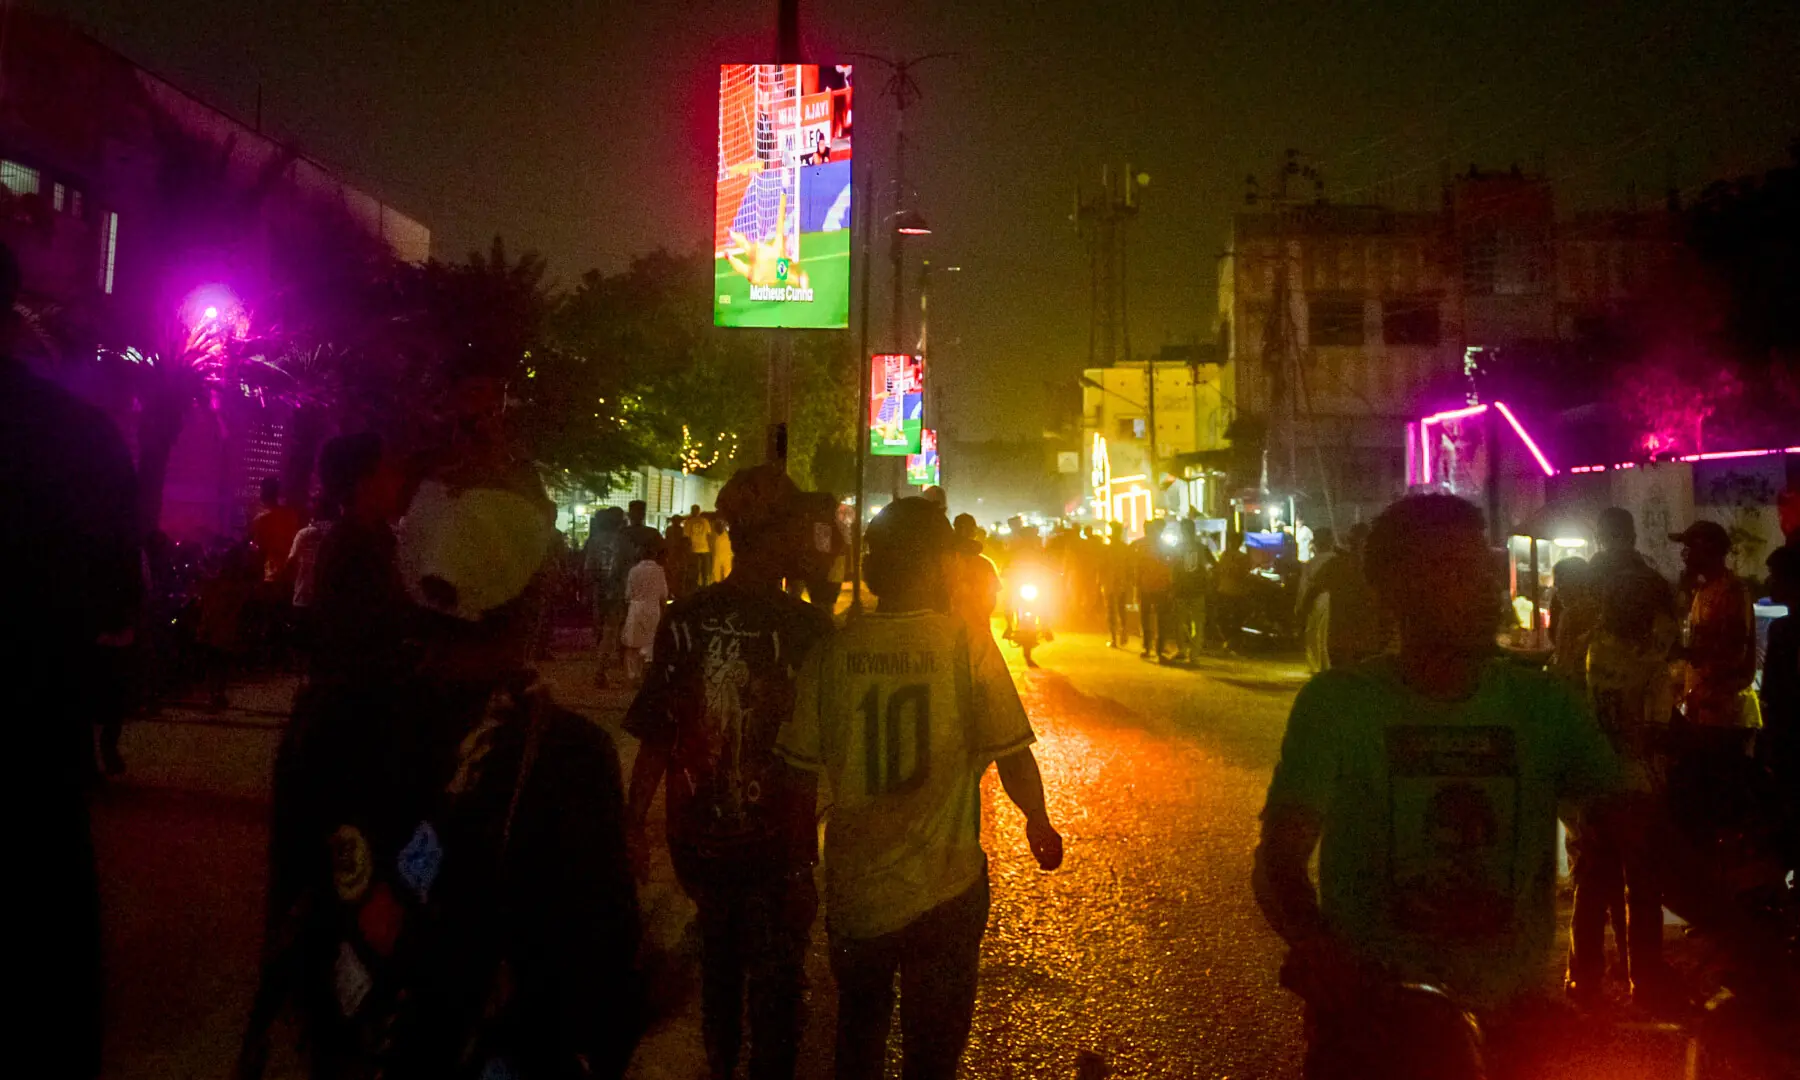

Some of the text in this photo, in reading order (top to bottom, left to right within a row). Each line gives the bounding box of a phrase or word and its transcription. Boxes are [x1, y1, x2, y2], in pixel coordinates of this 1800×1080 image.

[750, 284, 785, 301] Matheus
[786, 285, 813, 302] Cunha
[855, 682, 929, 796] 10
